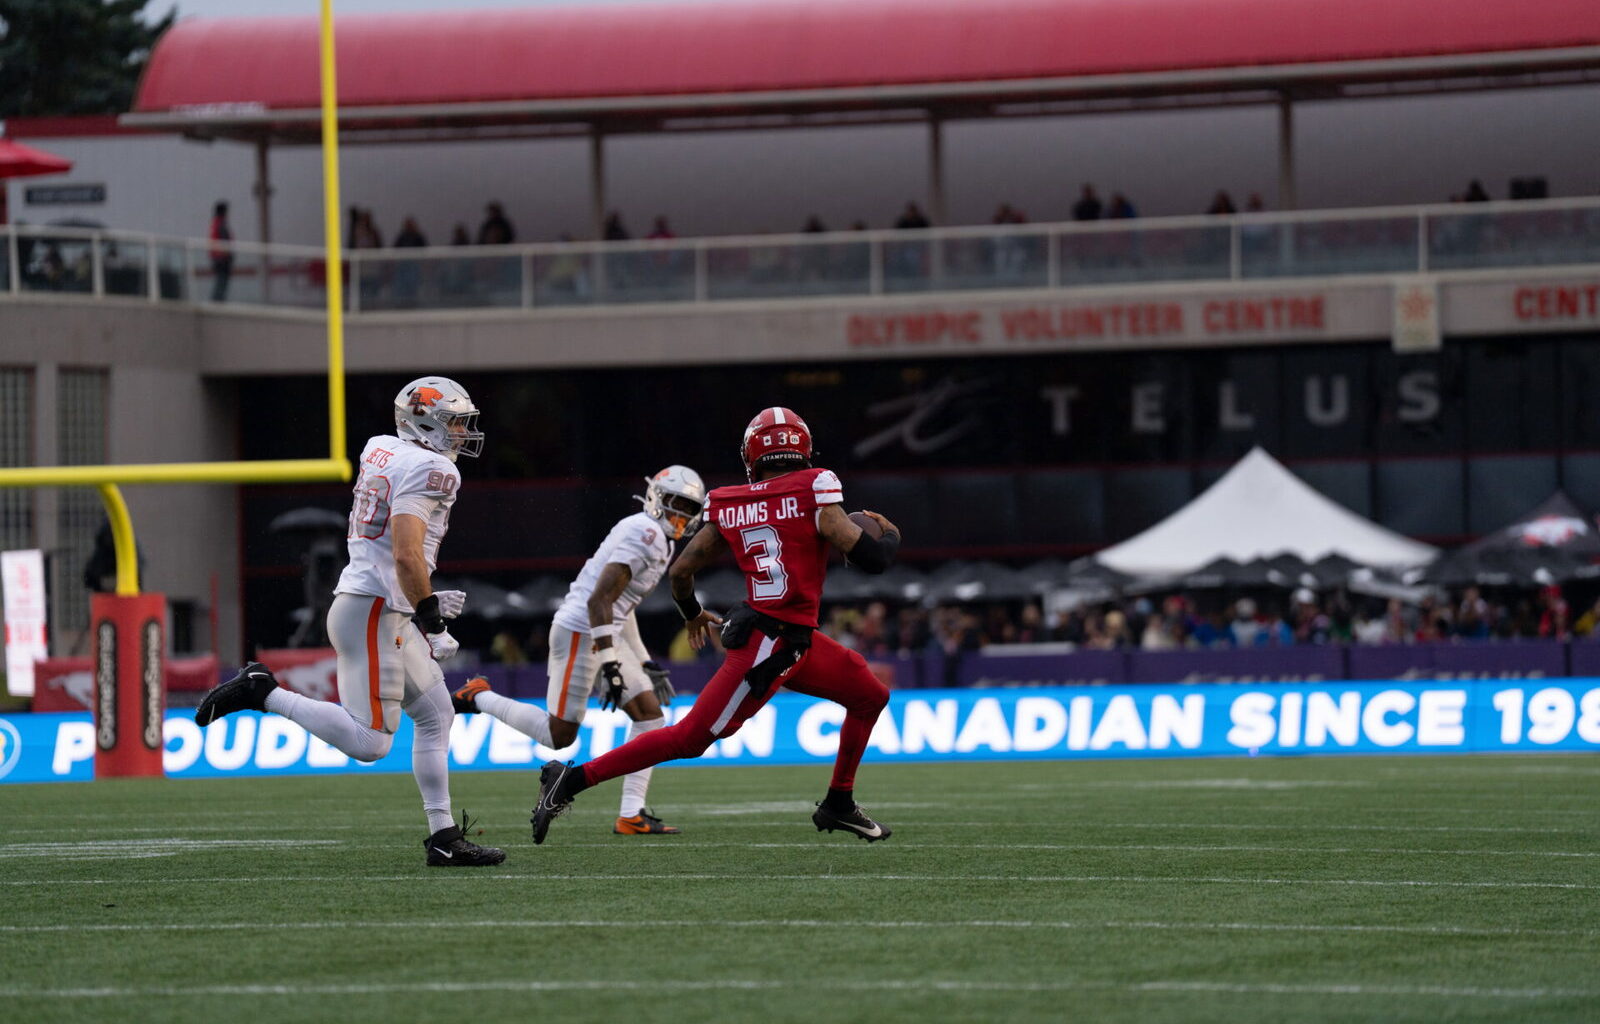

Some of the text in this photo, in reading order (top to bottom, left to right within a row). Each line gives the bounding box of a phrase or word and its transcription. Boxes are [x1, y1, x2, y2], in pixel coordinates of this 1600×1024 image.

[846, 294, 1326, 347] OLYMPIC VOLUNTEER CENTRE
[1040, 371, 1441, 437] TELUS
[777, 431, 788, 446] 3
[762, 453, 803, 462] STAMPEDERS
[425, 470, 457, 495] 90
[718, 497, 805, 529] ADAMS JR.
[641, 528, 657, 546] 3
[740, 524, 789, 601] 3
[1226, 688, 1467, 748] SINCE
